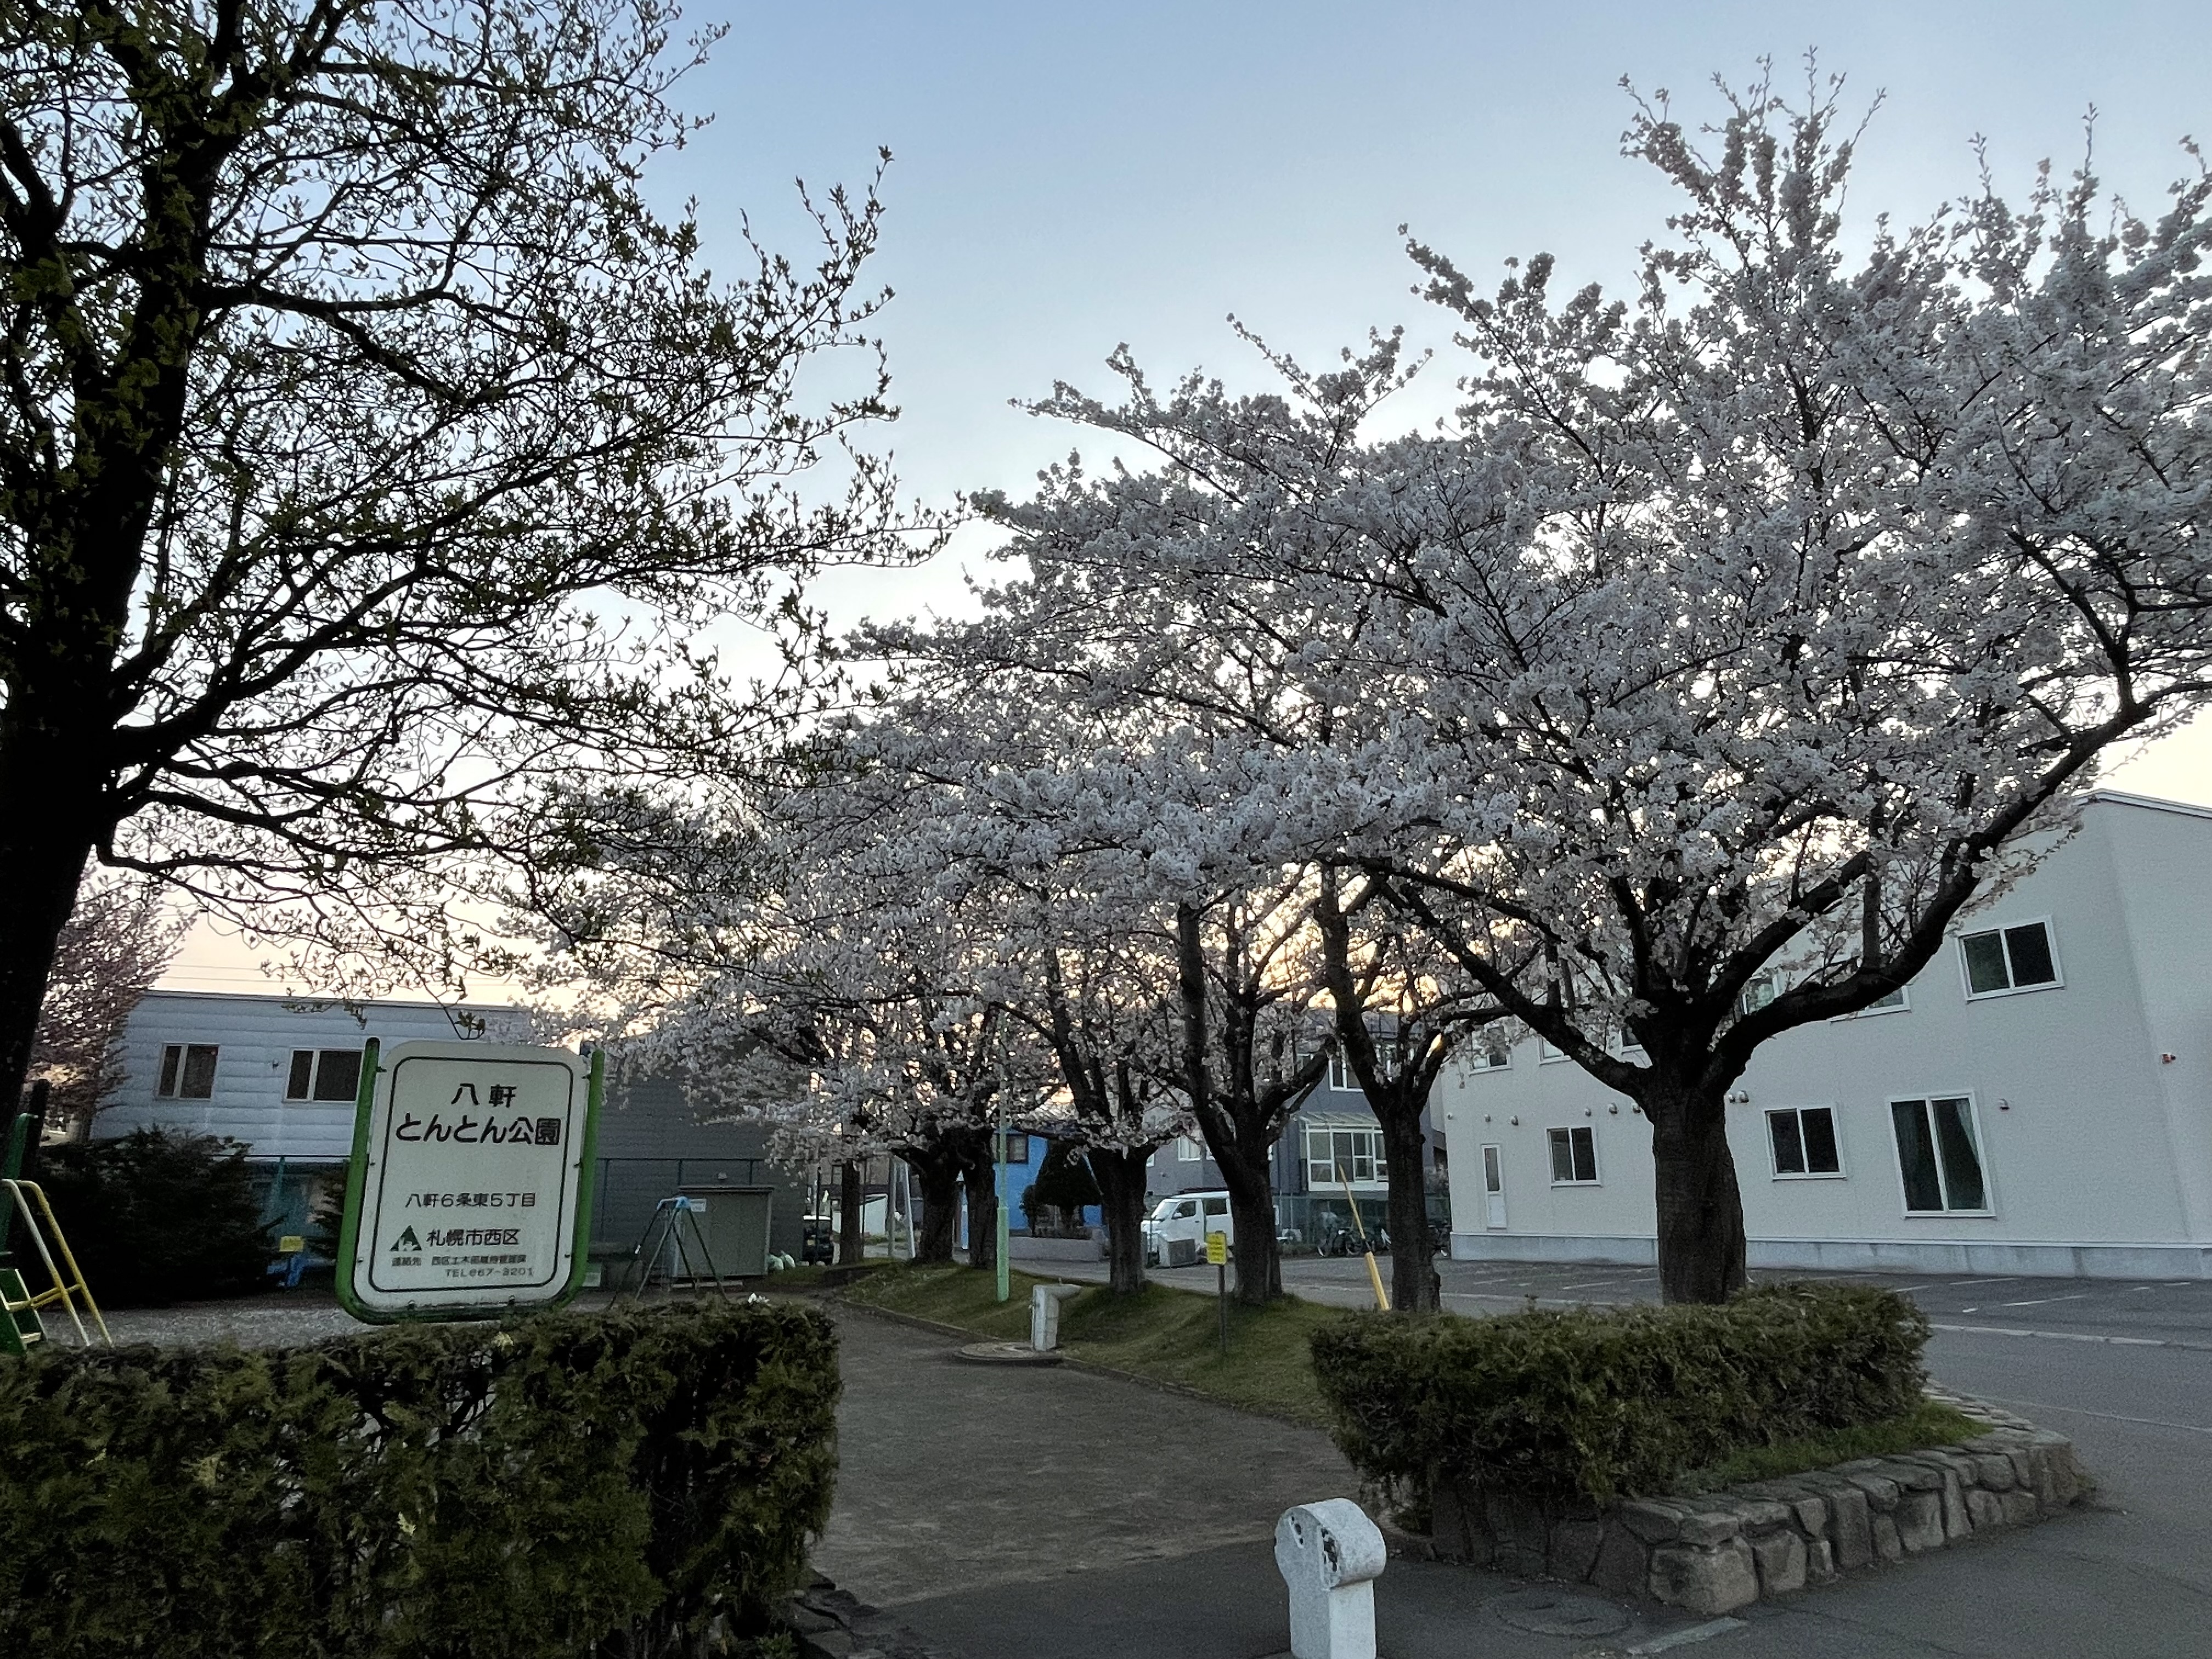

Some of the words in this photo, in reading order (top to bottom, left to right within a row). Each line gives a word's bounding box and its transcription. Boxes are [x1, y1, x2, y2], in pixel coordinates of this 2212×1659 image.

[451, 1083, 518, 1108] 八軒
[395, 1112, 562, 1146] とんとん公園
[405, 1193, 536, 1208] 八軒6条東5丁目
[426, 1228, 521, 1247] 札幌市西区
